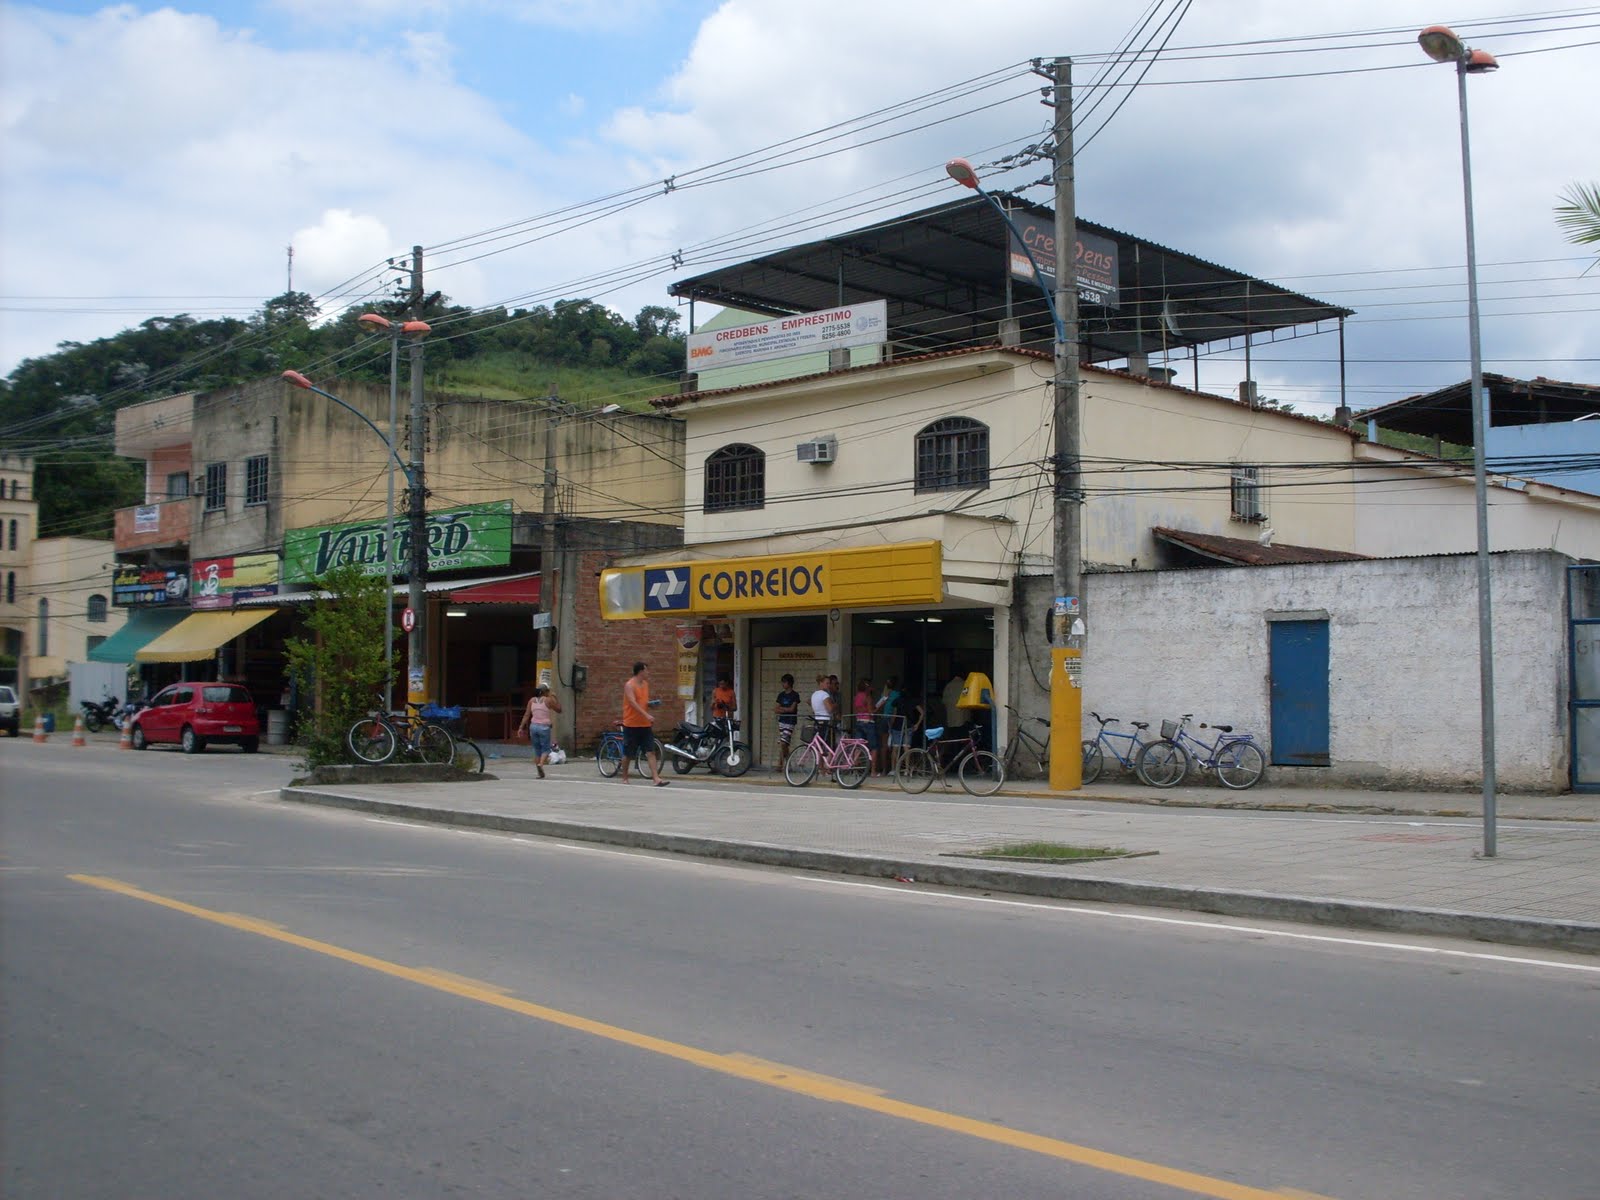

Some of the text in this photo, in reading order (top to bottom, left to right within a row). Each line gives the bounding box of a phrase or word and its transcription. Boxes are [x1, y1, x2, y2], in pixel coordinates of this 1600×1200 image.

[1022, 225, 1113, 270] Creens
[715, 325, 769, 342] CREDBENS
[781, 309, 852, 331] EMPRÉSTIMO
[821, 322, 851, 334] 2775-5538
[699, 565, 824, 601] CORREIOS
